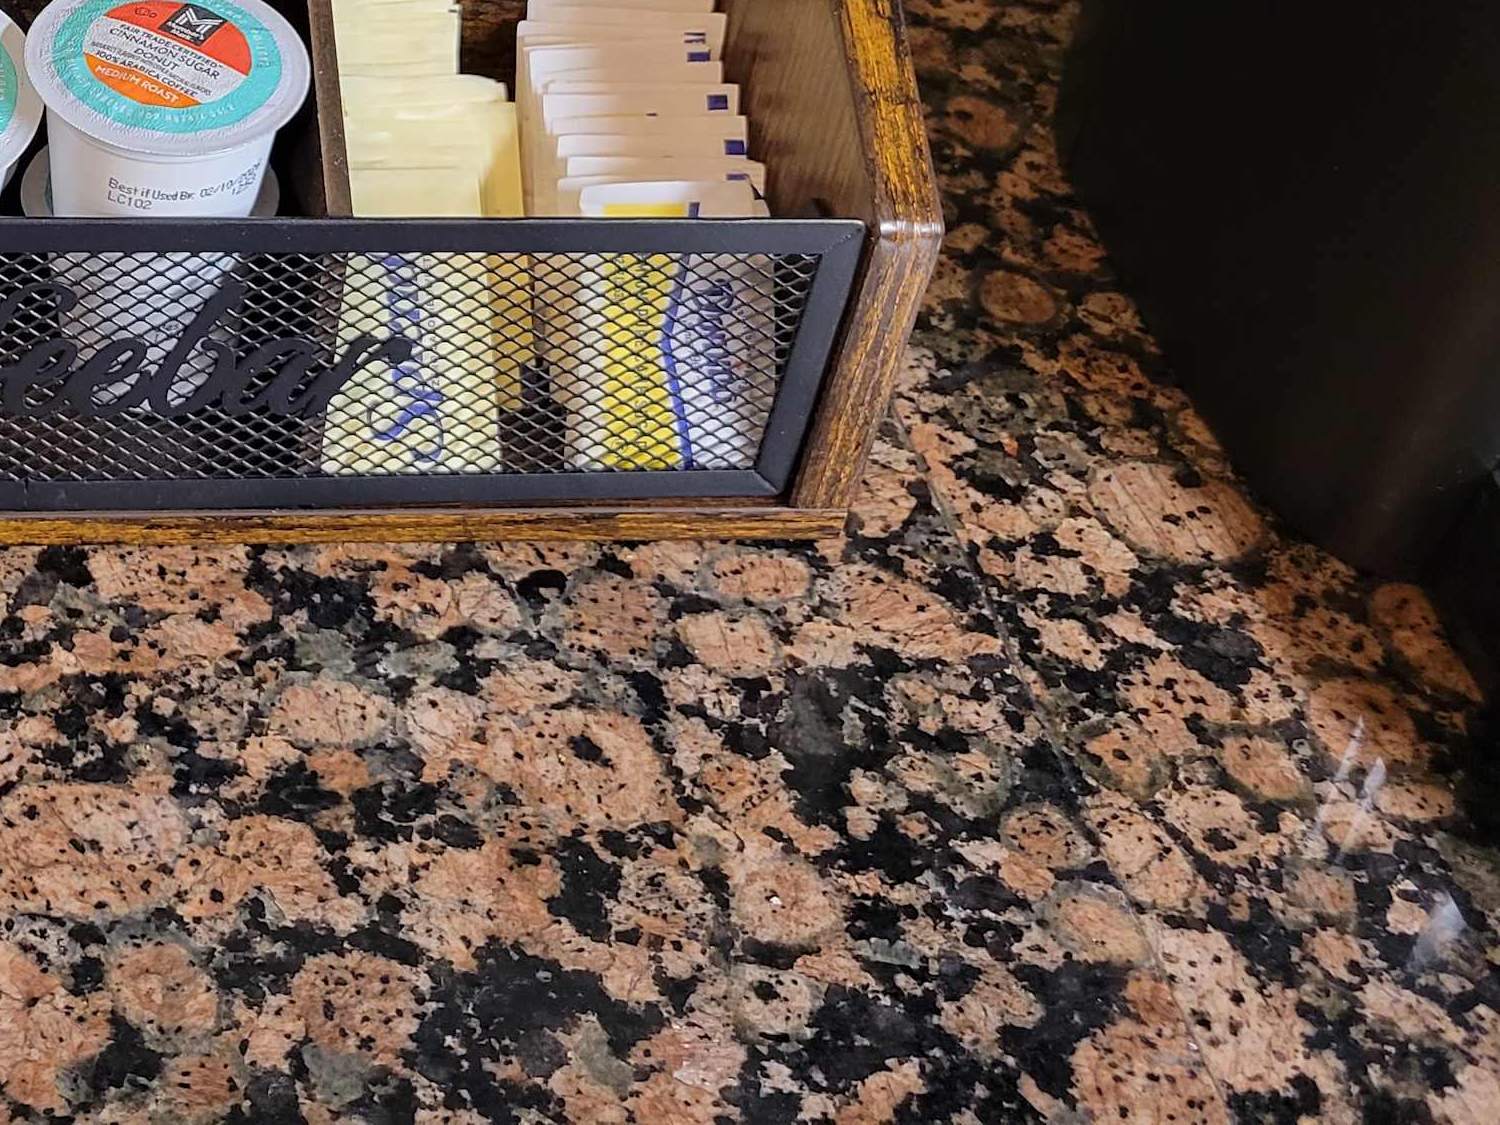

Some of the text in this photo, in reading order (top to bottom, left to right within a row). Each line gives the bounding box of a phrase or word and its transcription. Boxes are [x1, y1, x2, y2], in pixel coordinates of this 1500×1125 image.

[120, 23, 141, 36] FAIR
[141, 31, 173, 49] TRADE
[109, 27, 180, 59] CINNAMON
[178, 53, 221, 80] SUGAR
[133, 47, 181, 71] DONUT
[94, 64, 141, 85] MEDIUM
[140, 78, 181, 105] ROAST
[95, 49, 199, 98] 100% ARABICA COFFEE
[107, 190, 153, 211] LC102
[108, 177, 138, 196] Best
[140, 187, 151, 198] if
[151, 191, 178, 202] Used
